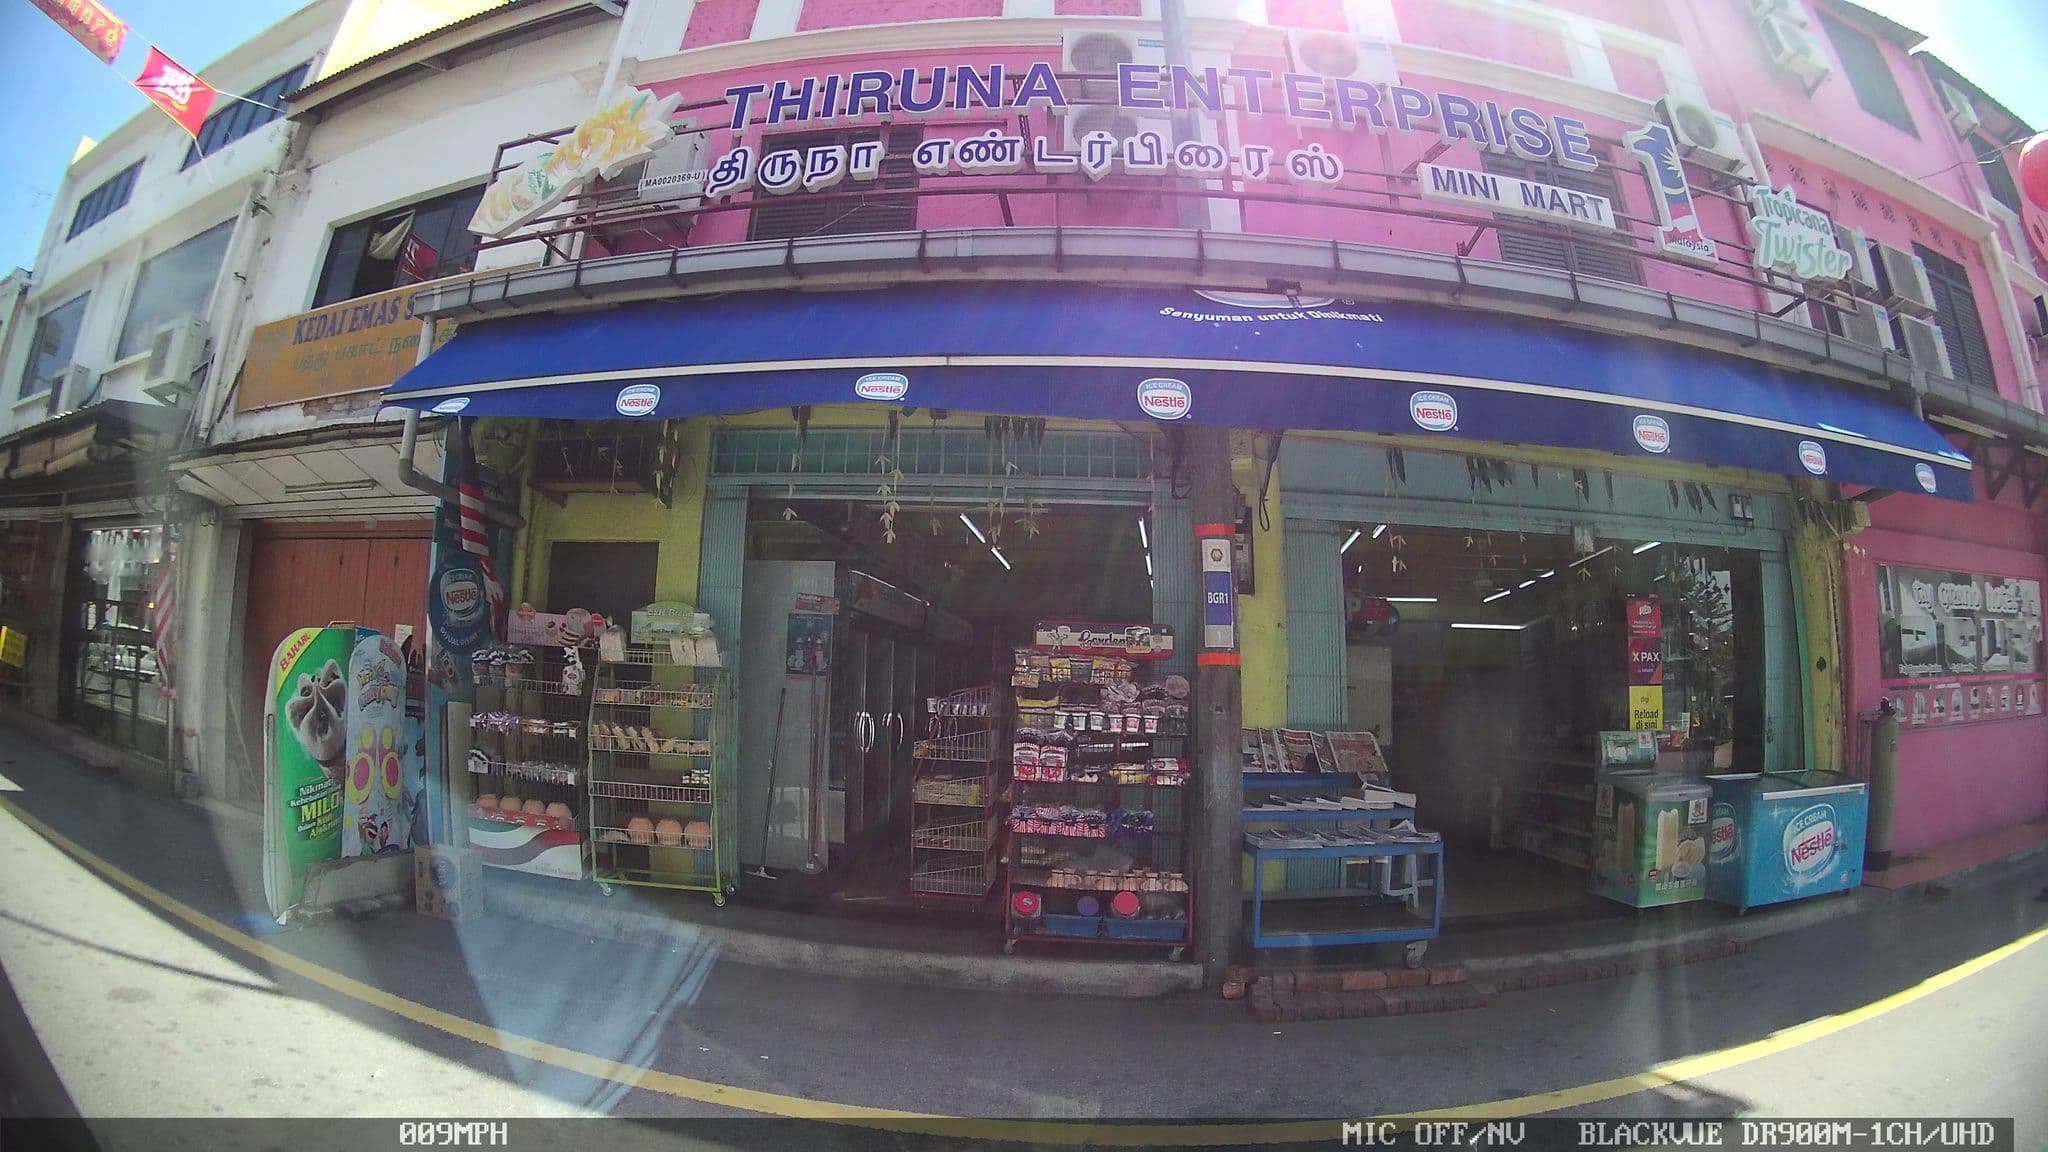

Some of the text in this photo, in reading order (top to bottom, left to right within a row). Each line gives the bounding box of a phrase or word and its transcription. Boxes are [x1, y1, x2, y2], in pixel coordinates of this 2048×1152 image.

[725, 62, 1599, 168] THIRUNA ENTERPRISE
[706, 146, 882, 196] திருநா
[1431, 166, 1603, 221] MINI MART
[1756, 188, 1831, 237] Tropicana
[1753, 219, 1851, 276] Twister
[292, 310, 347, 346] KEDAI
[348, 296, 402, 333] EMAS
[1159, 306, 1385, 323] Senyuman untuk Dinikmati
[1207, 592, 1229, 604] BGR1
[1634, 709, 1659, 719] Reload
[1635, 720, 1658, 730] di sini
